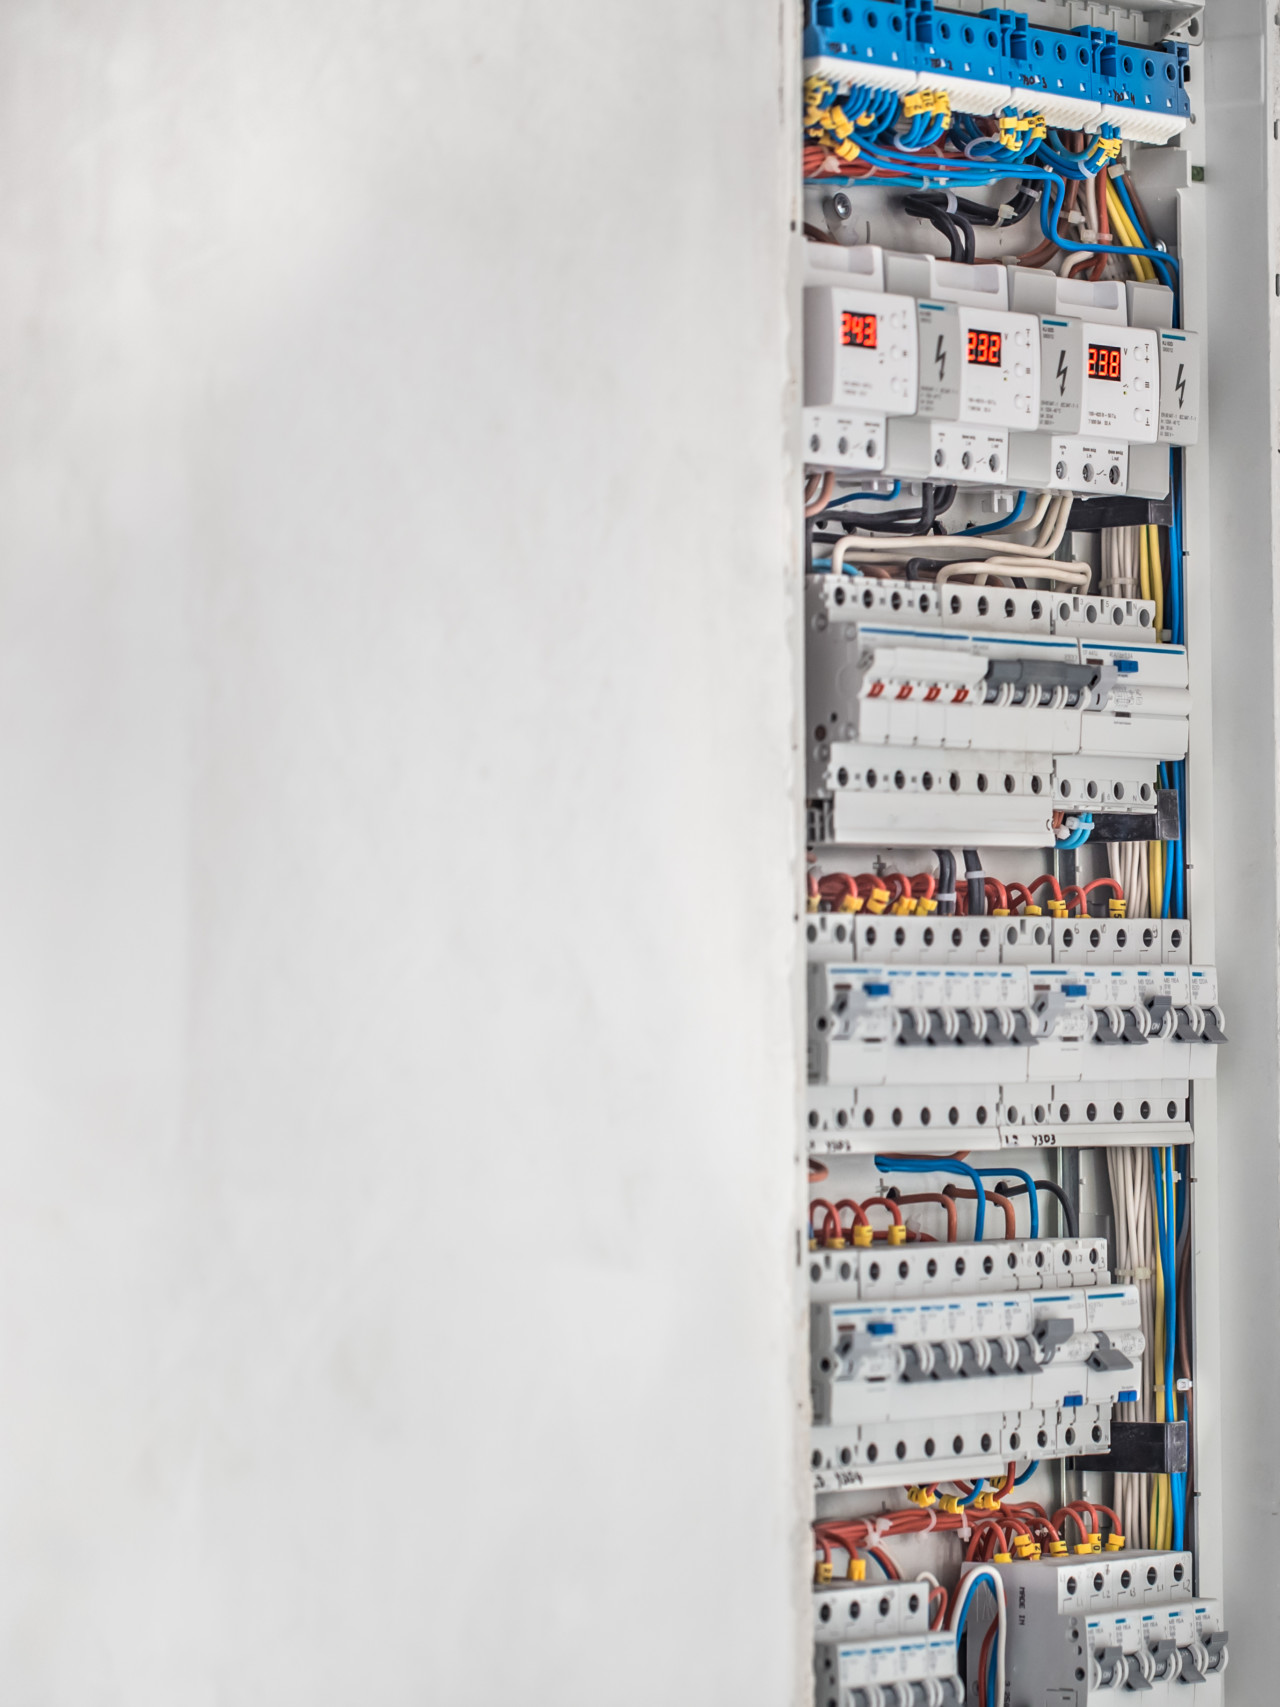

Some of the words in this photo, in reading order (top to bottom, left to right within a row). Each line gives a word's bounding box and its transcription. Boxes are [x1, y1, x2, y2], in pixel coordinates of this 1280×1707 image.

[966, 331, 1001, 364] 232
[1087, 347, 1121, 378] 238
[1151, 1022, 1161, 1030] ON
[1018, 1586, 1026, 1609] MADE
[1156, 1663, 1165, 1671] ON
